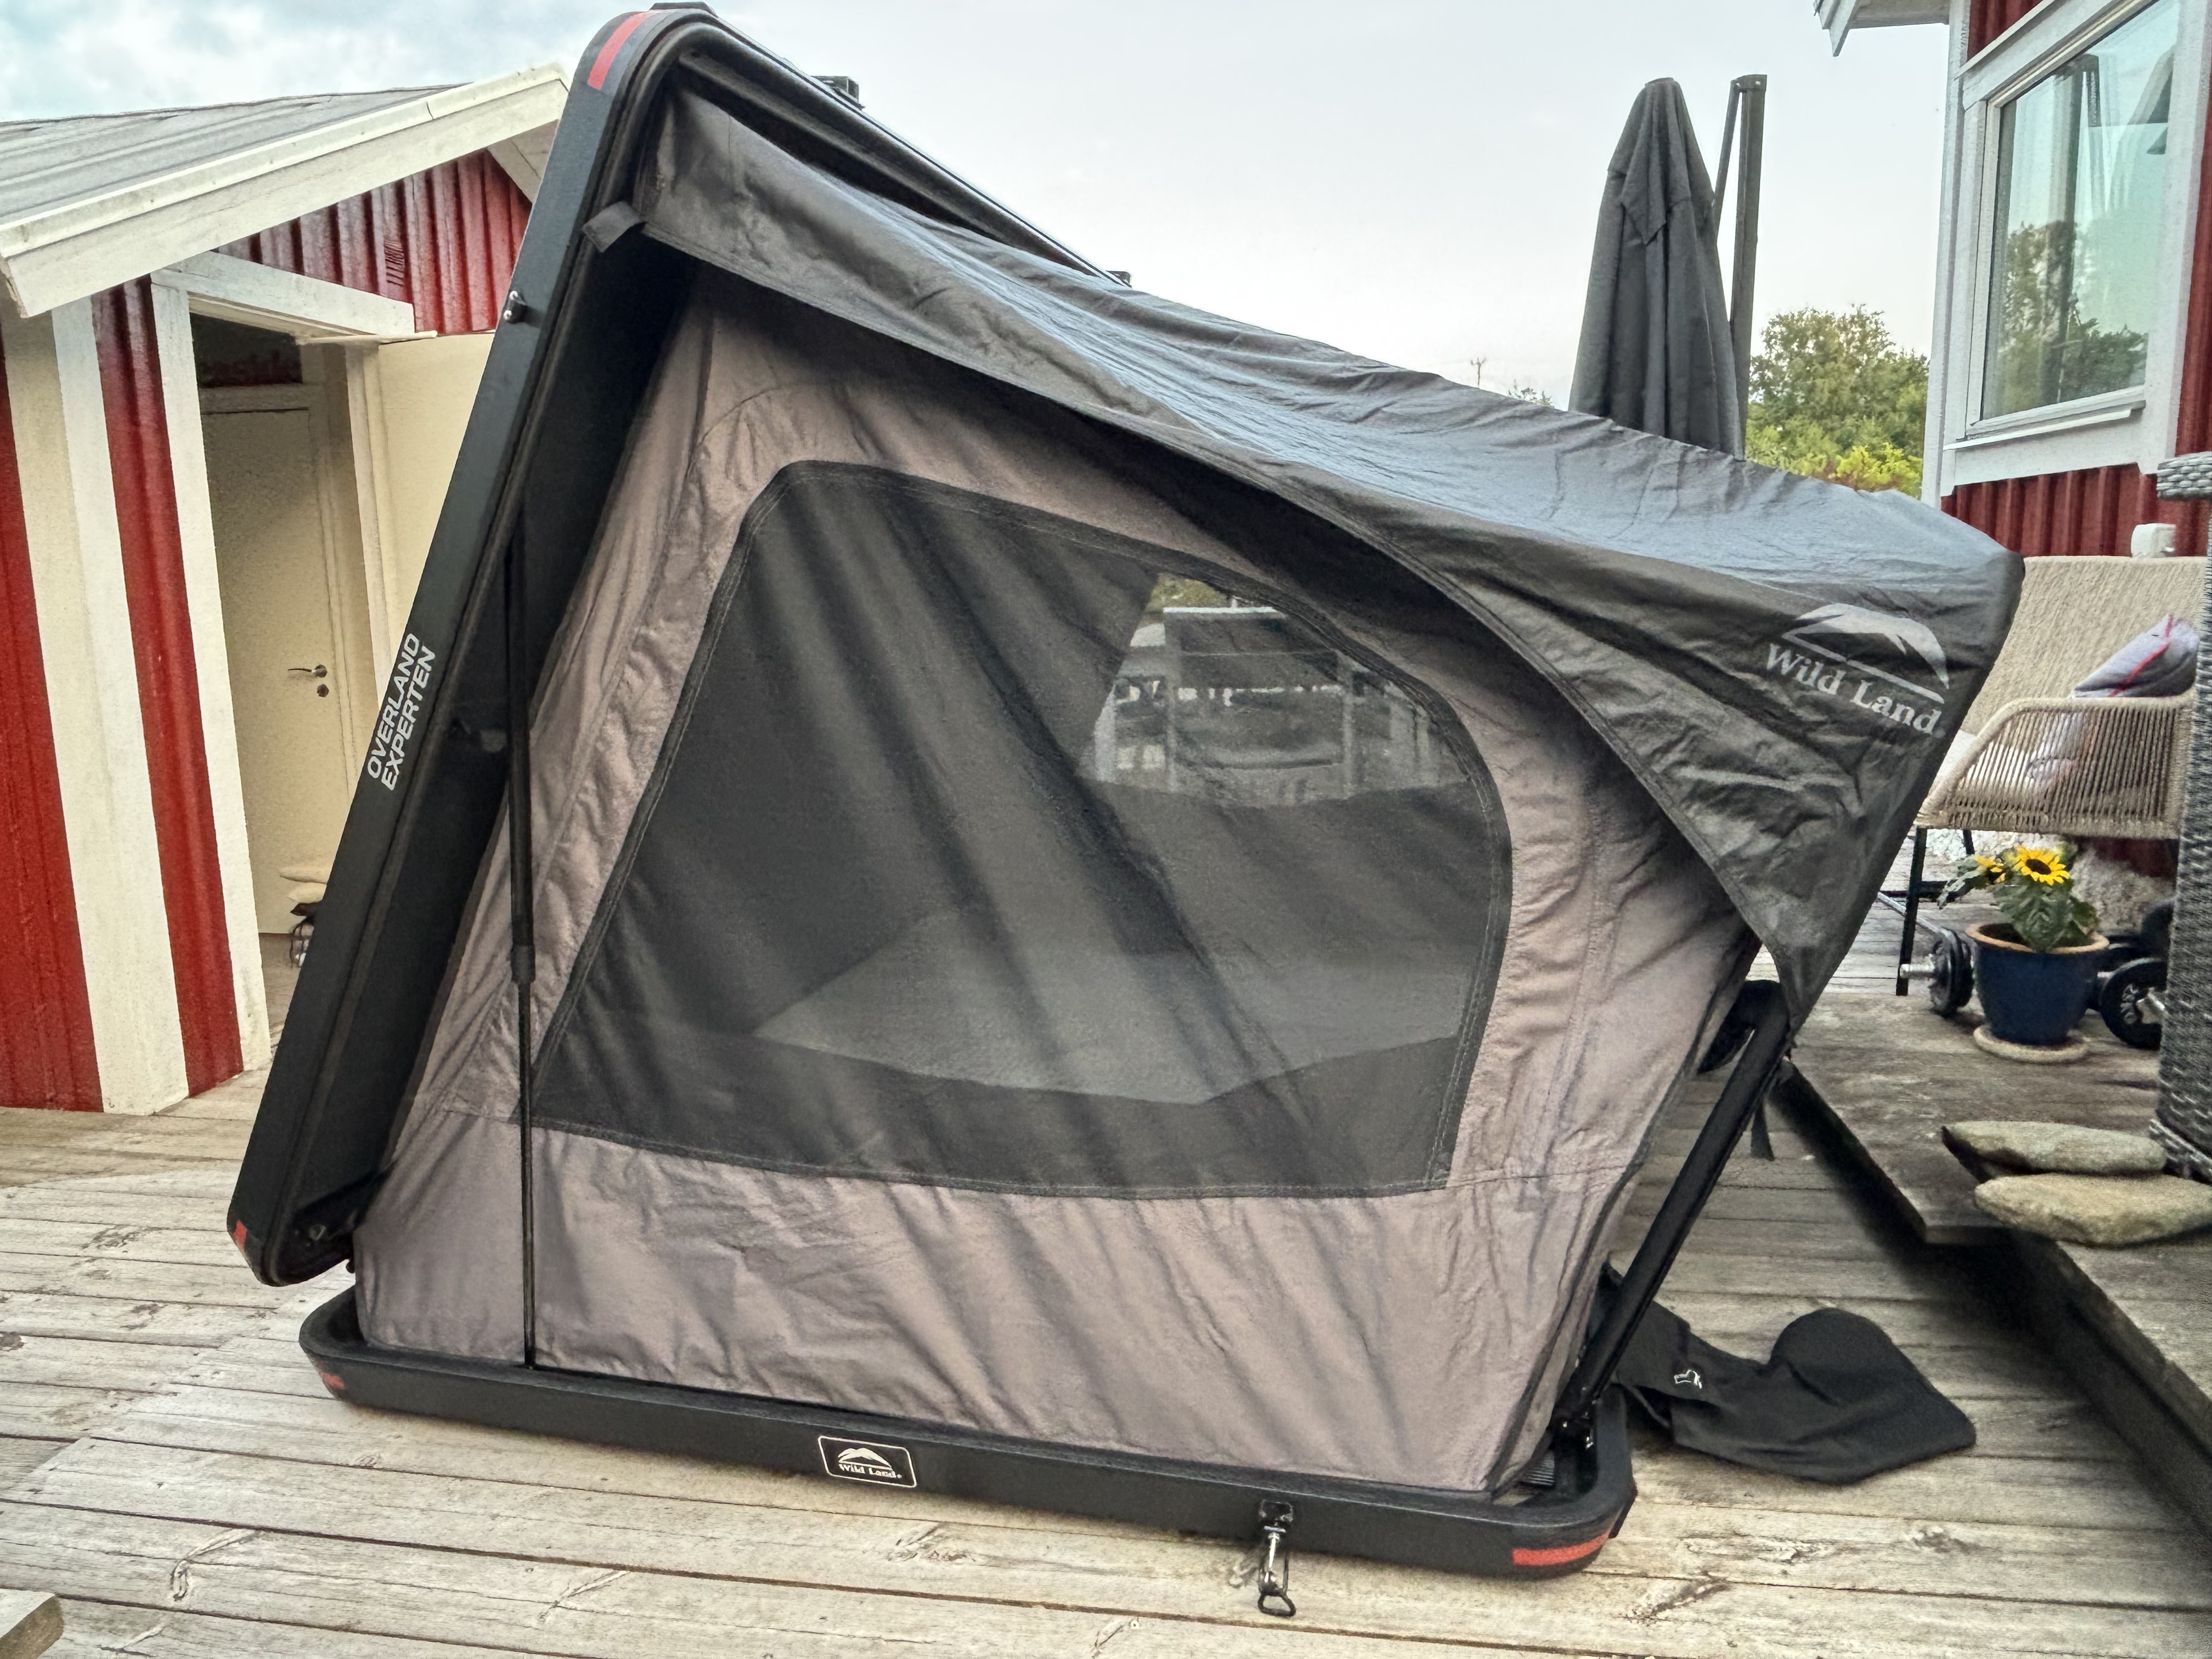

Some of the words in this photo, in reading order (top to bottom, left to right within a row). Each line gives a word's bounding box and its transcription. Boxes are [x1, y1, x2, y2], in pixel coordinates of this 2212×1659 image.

[368, 634, 419, 778] OVERLAND
[381, 645, 435, 791] EXPERTEN
[1765, 644, 1847, 695] Wild
[1850, 680, 1942, 735] Land
[838, 1463, 866, 1474] Wild
